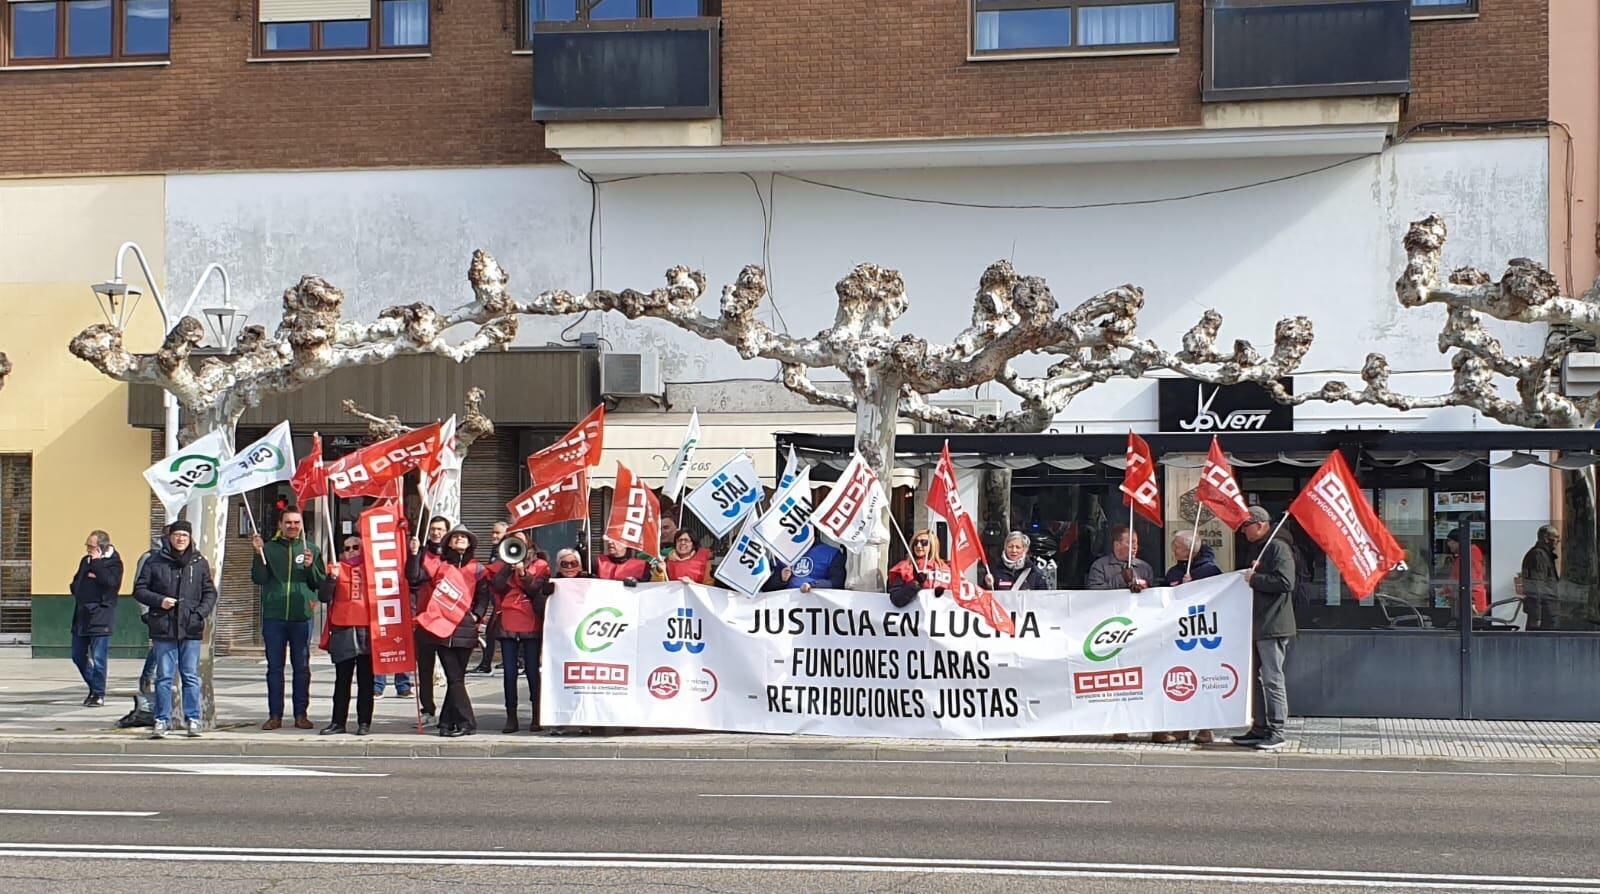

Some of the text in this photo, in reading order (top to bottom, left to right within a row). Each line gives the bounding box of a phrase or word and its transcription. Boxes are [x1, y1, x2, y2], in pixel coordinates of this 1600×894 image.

[711, 474, 750, 510] STAJ
[779, 496, 815, 535] STAJ
[740, 539, 762, 569] STA
[368, 514, 402, 626] CCOO
[586, 620, 629, 639] CSIF
[667, 617, 702, 641] STAJ
[748, 608, 877, 637] JUSTICIA
[883, 610, 920, 637] EN
[1094, 627, 1138, 645] CSIF
[1178, 612, 1218, 638] STAJ
[567, 665, 626, 681] CCOO
[792, 647, 991, 680] FUNCIONES CLARAS
[1078, 671, 1140, 690] CCOO
[766, 685, 1019, 719] RETRIBUCIONES JUSTAS
